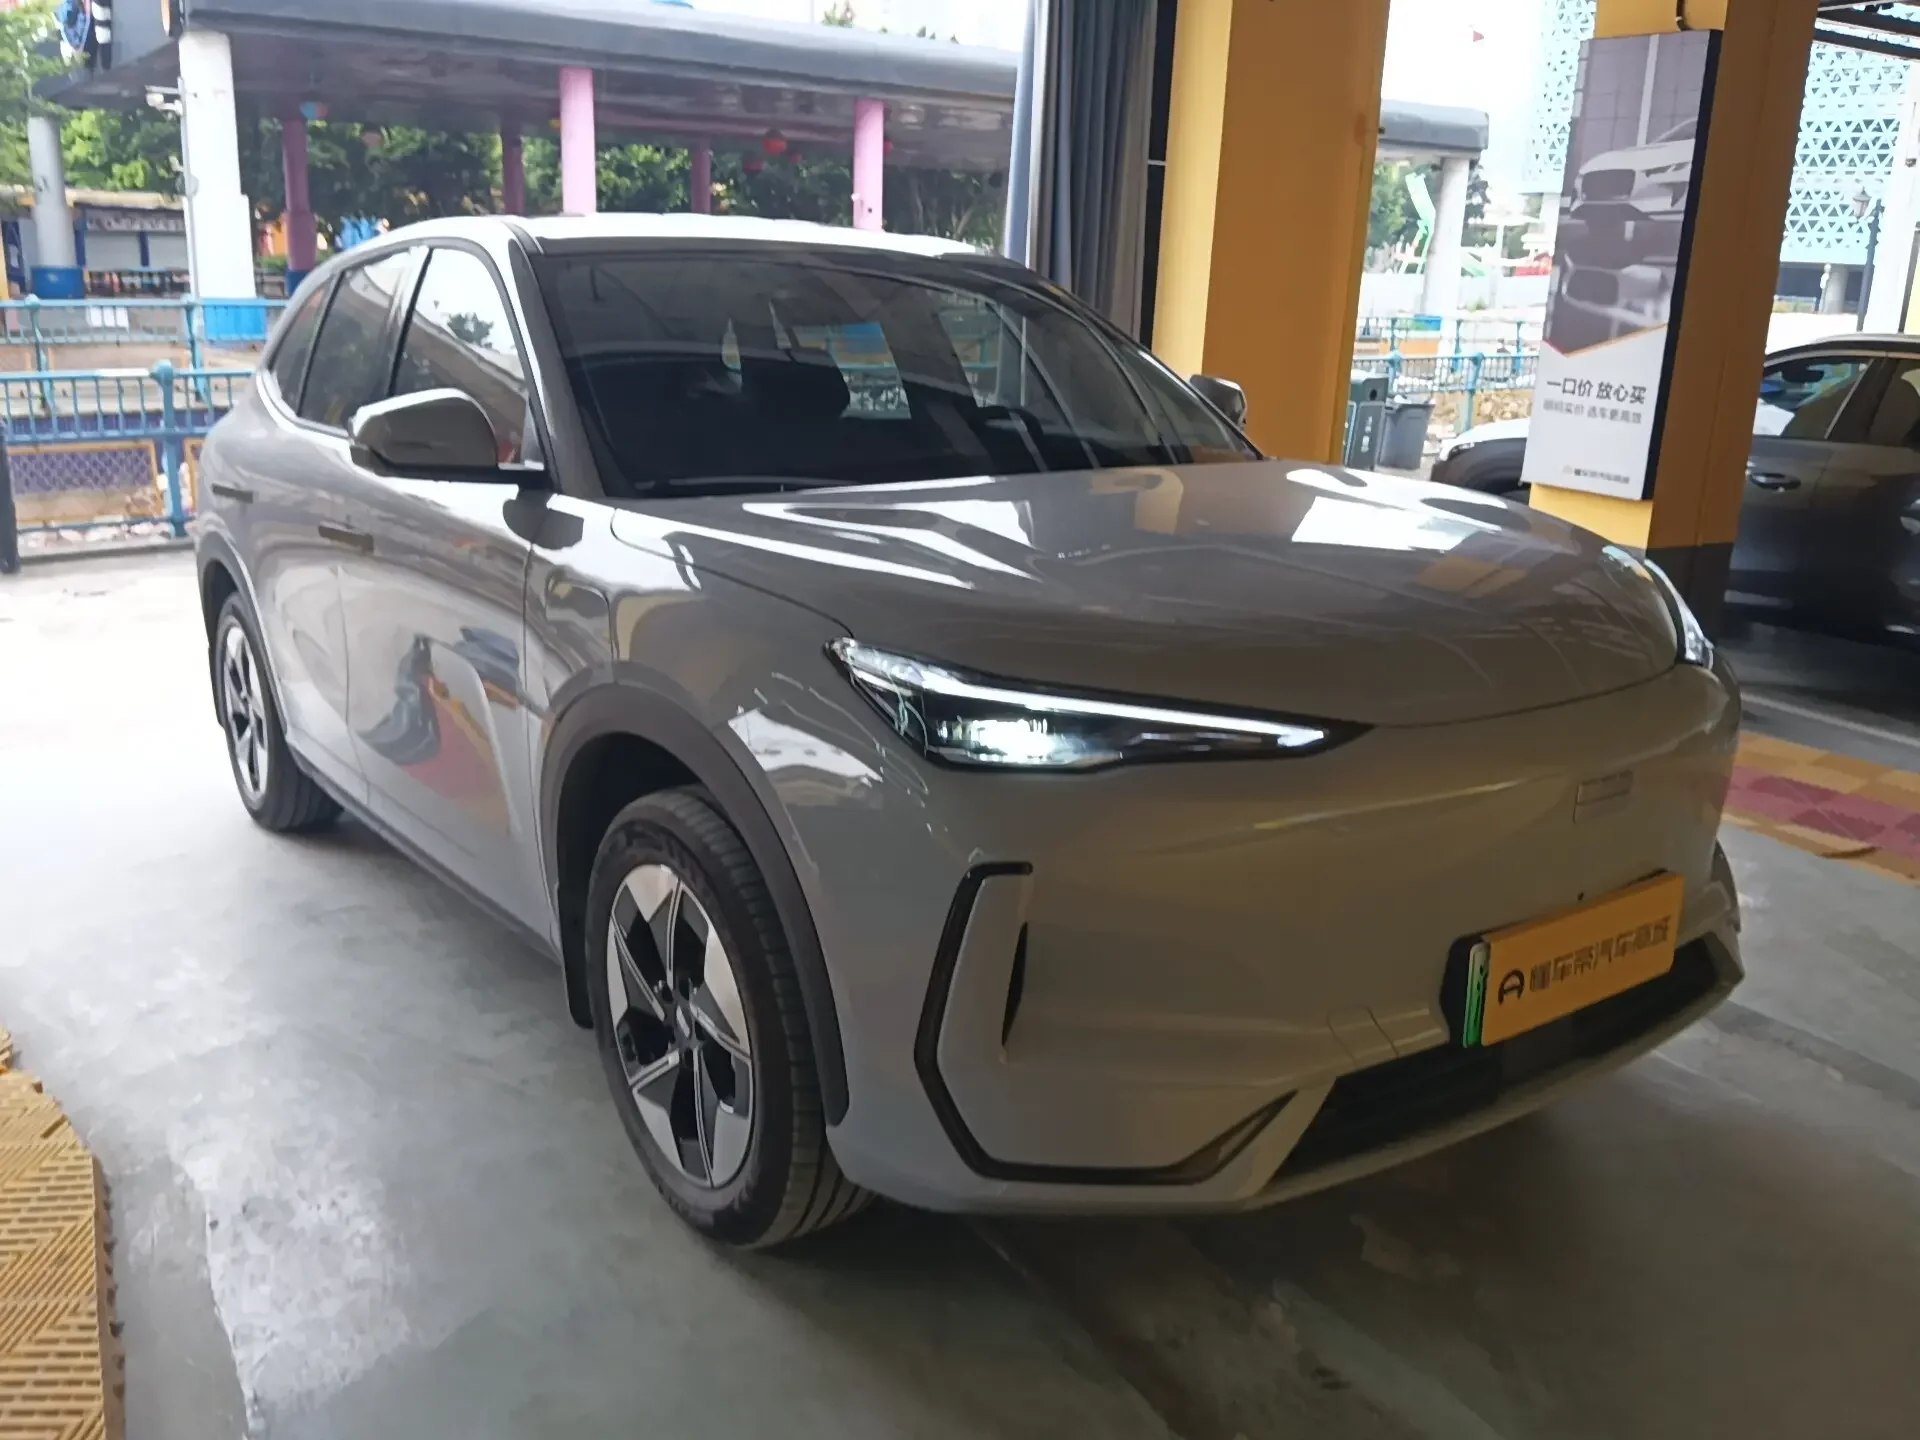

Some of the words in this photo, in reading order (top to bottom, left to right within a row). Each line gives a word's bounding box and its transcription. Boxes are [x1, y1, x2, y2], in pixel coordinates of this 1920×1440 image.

[1546, 377, 1594, 398] 一口价
[1596, 380, 1647, 405] 放心买
[1543, 399, 1585, 416] 实价
